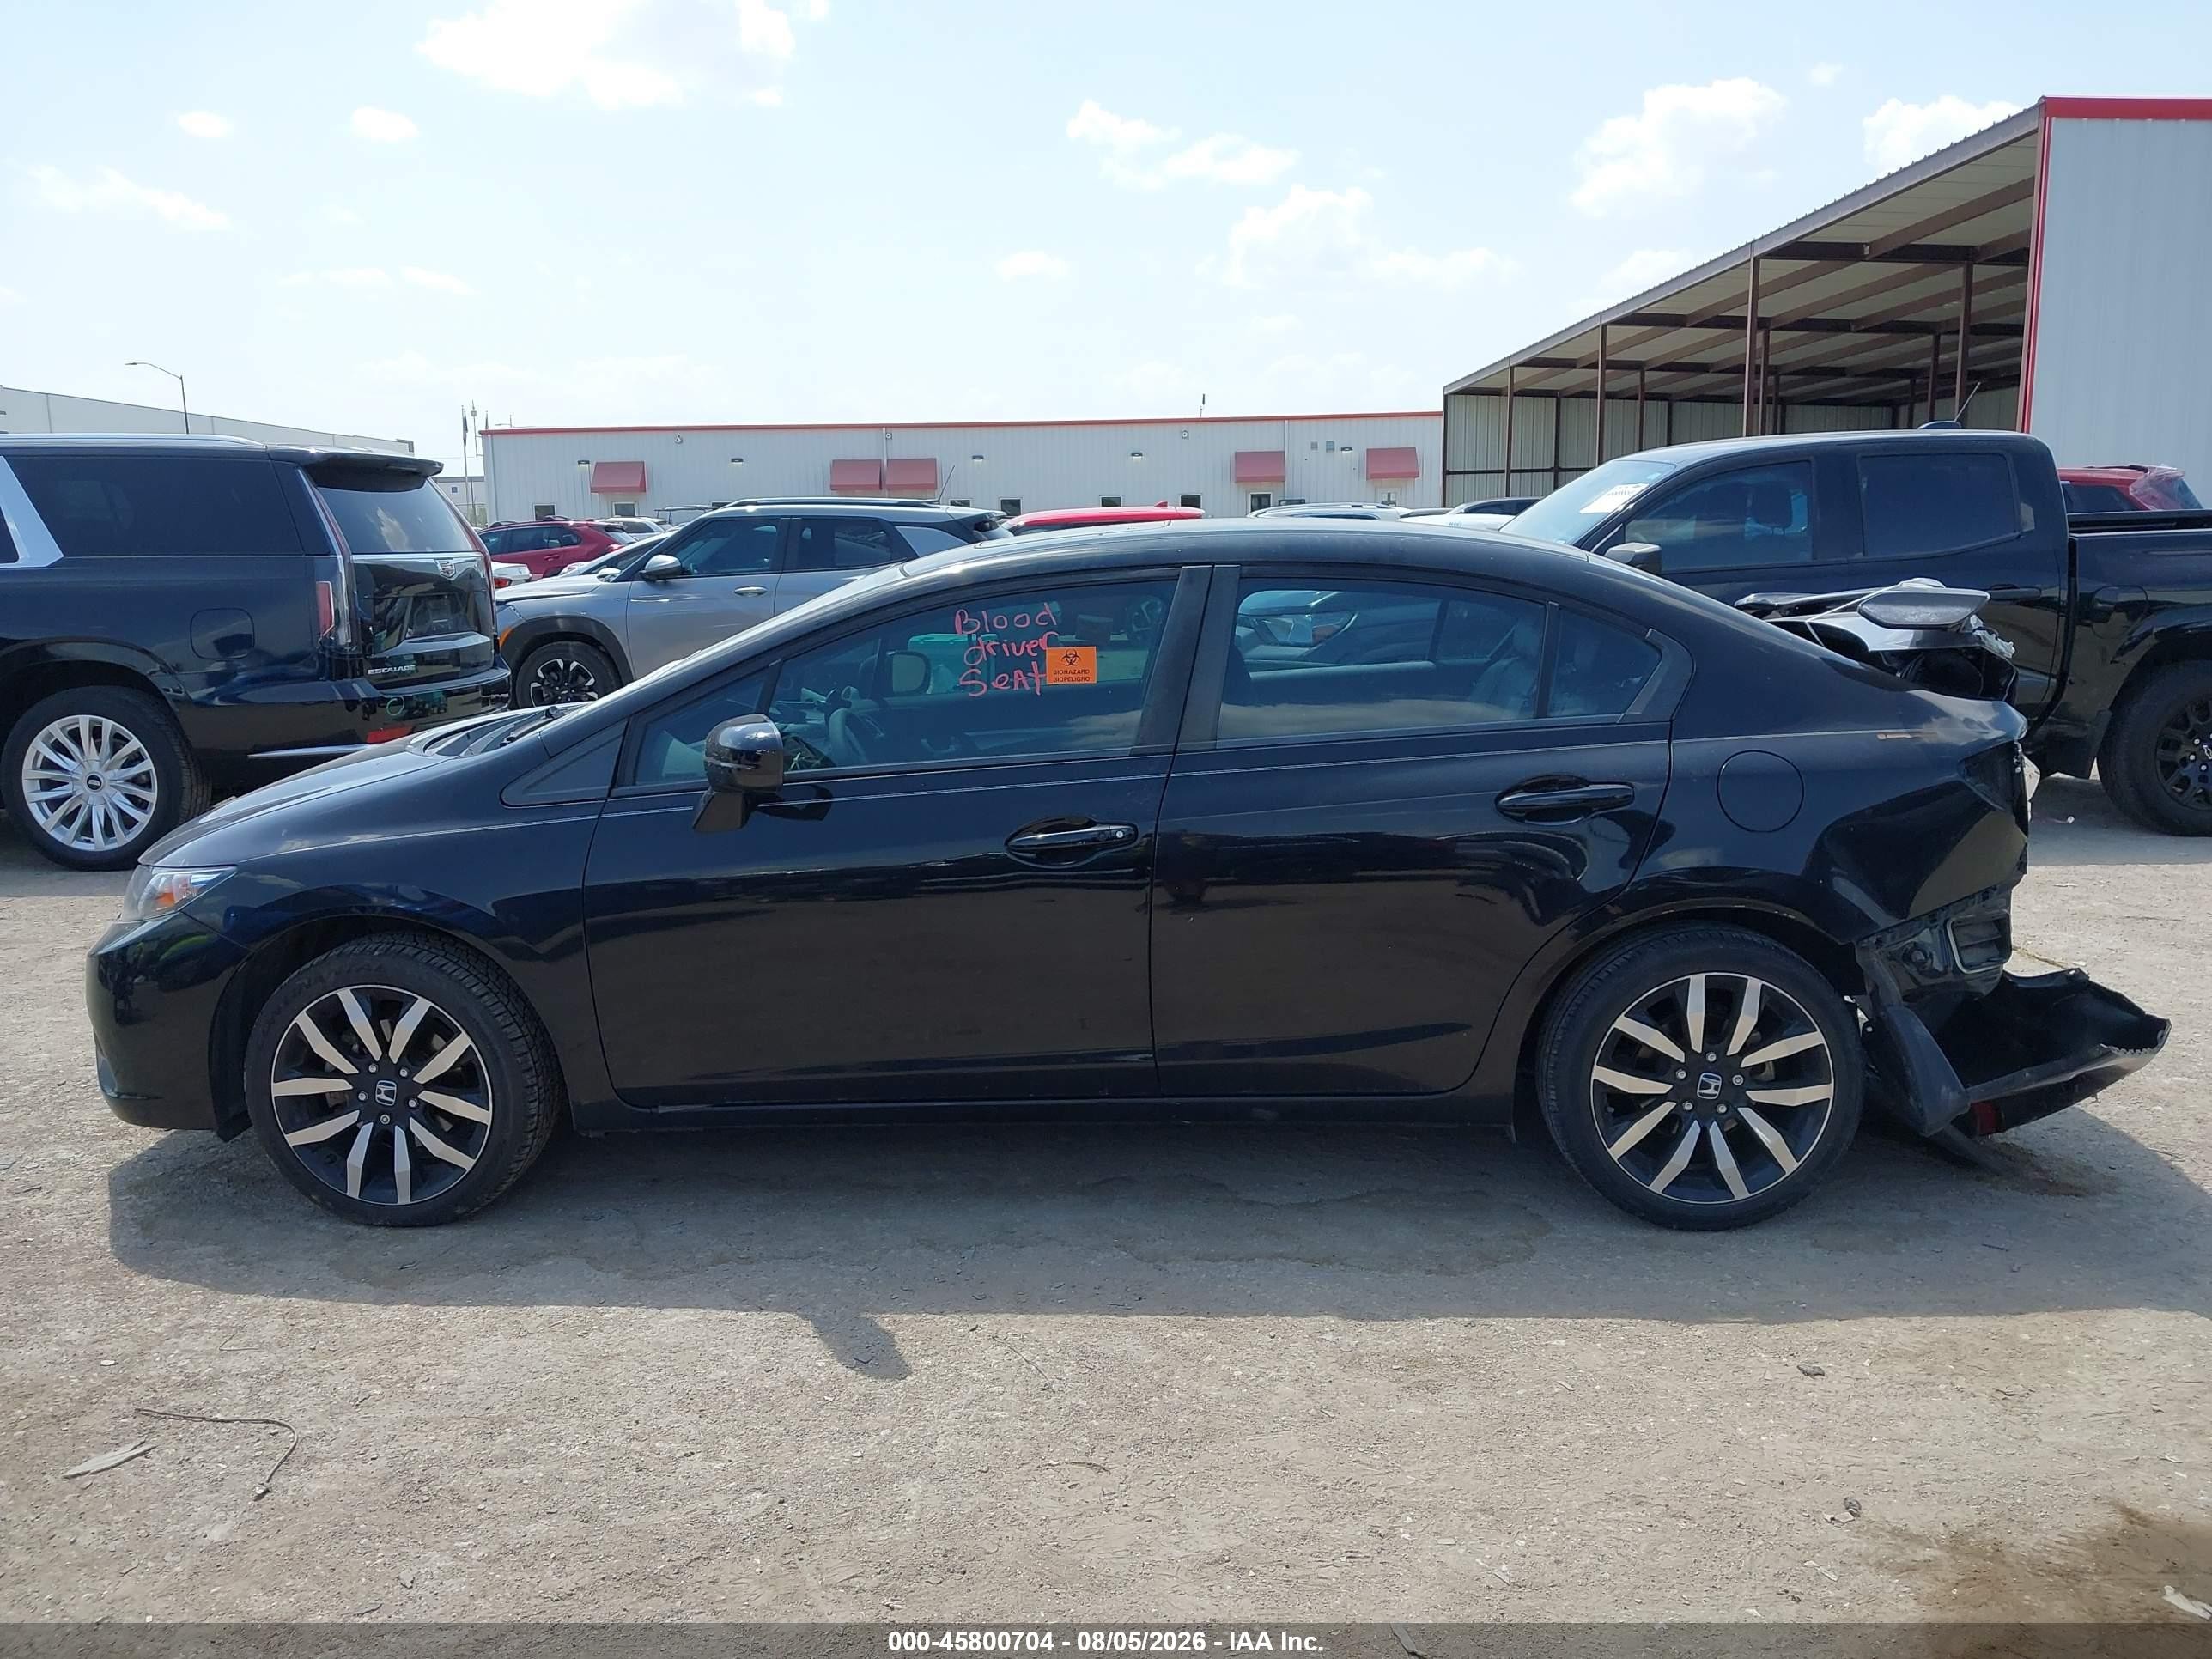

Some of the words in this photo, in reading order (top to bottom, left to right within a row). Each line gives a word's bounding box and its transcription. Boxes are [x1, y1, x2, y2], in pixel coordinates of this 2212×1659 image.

[955, 602, 1058, 635] Blood
[963, 632, 1059, 666] driver
[368, 665, 416, 675] ESCALADE
